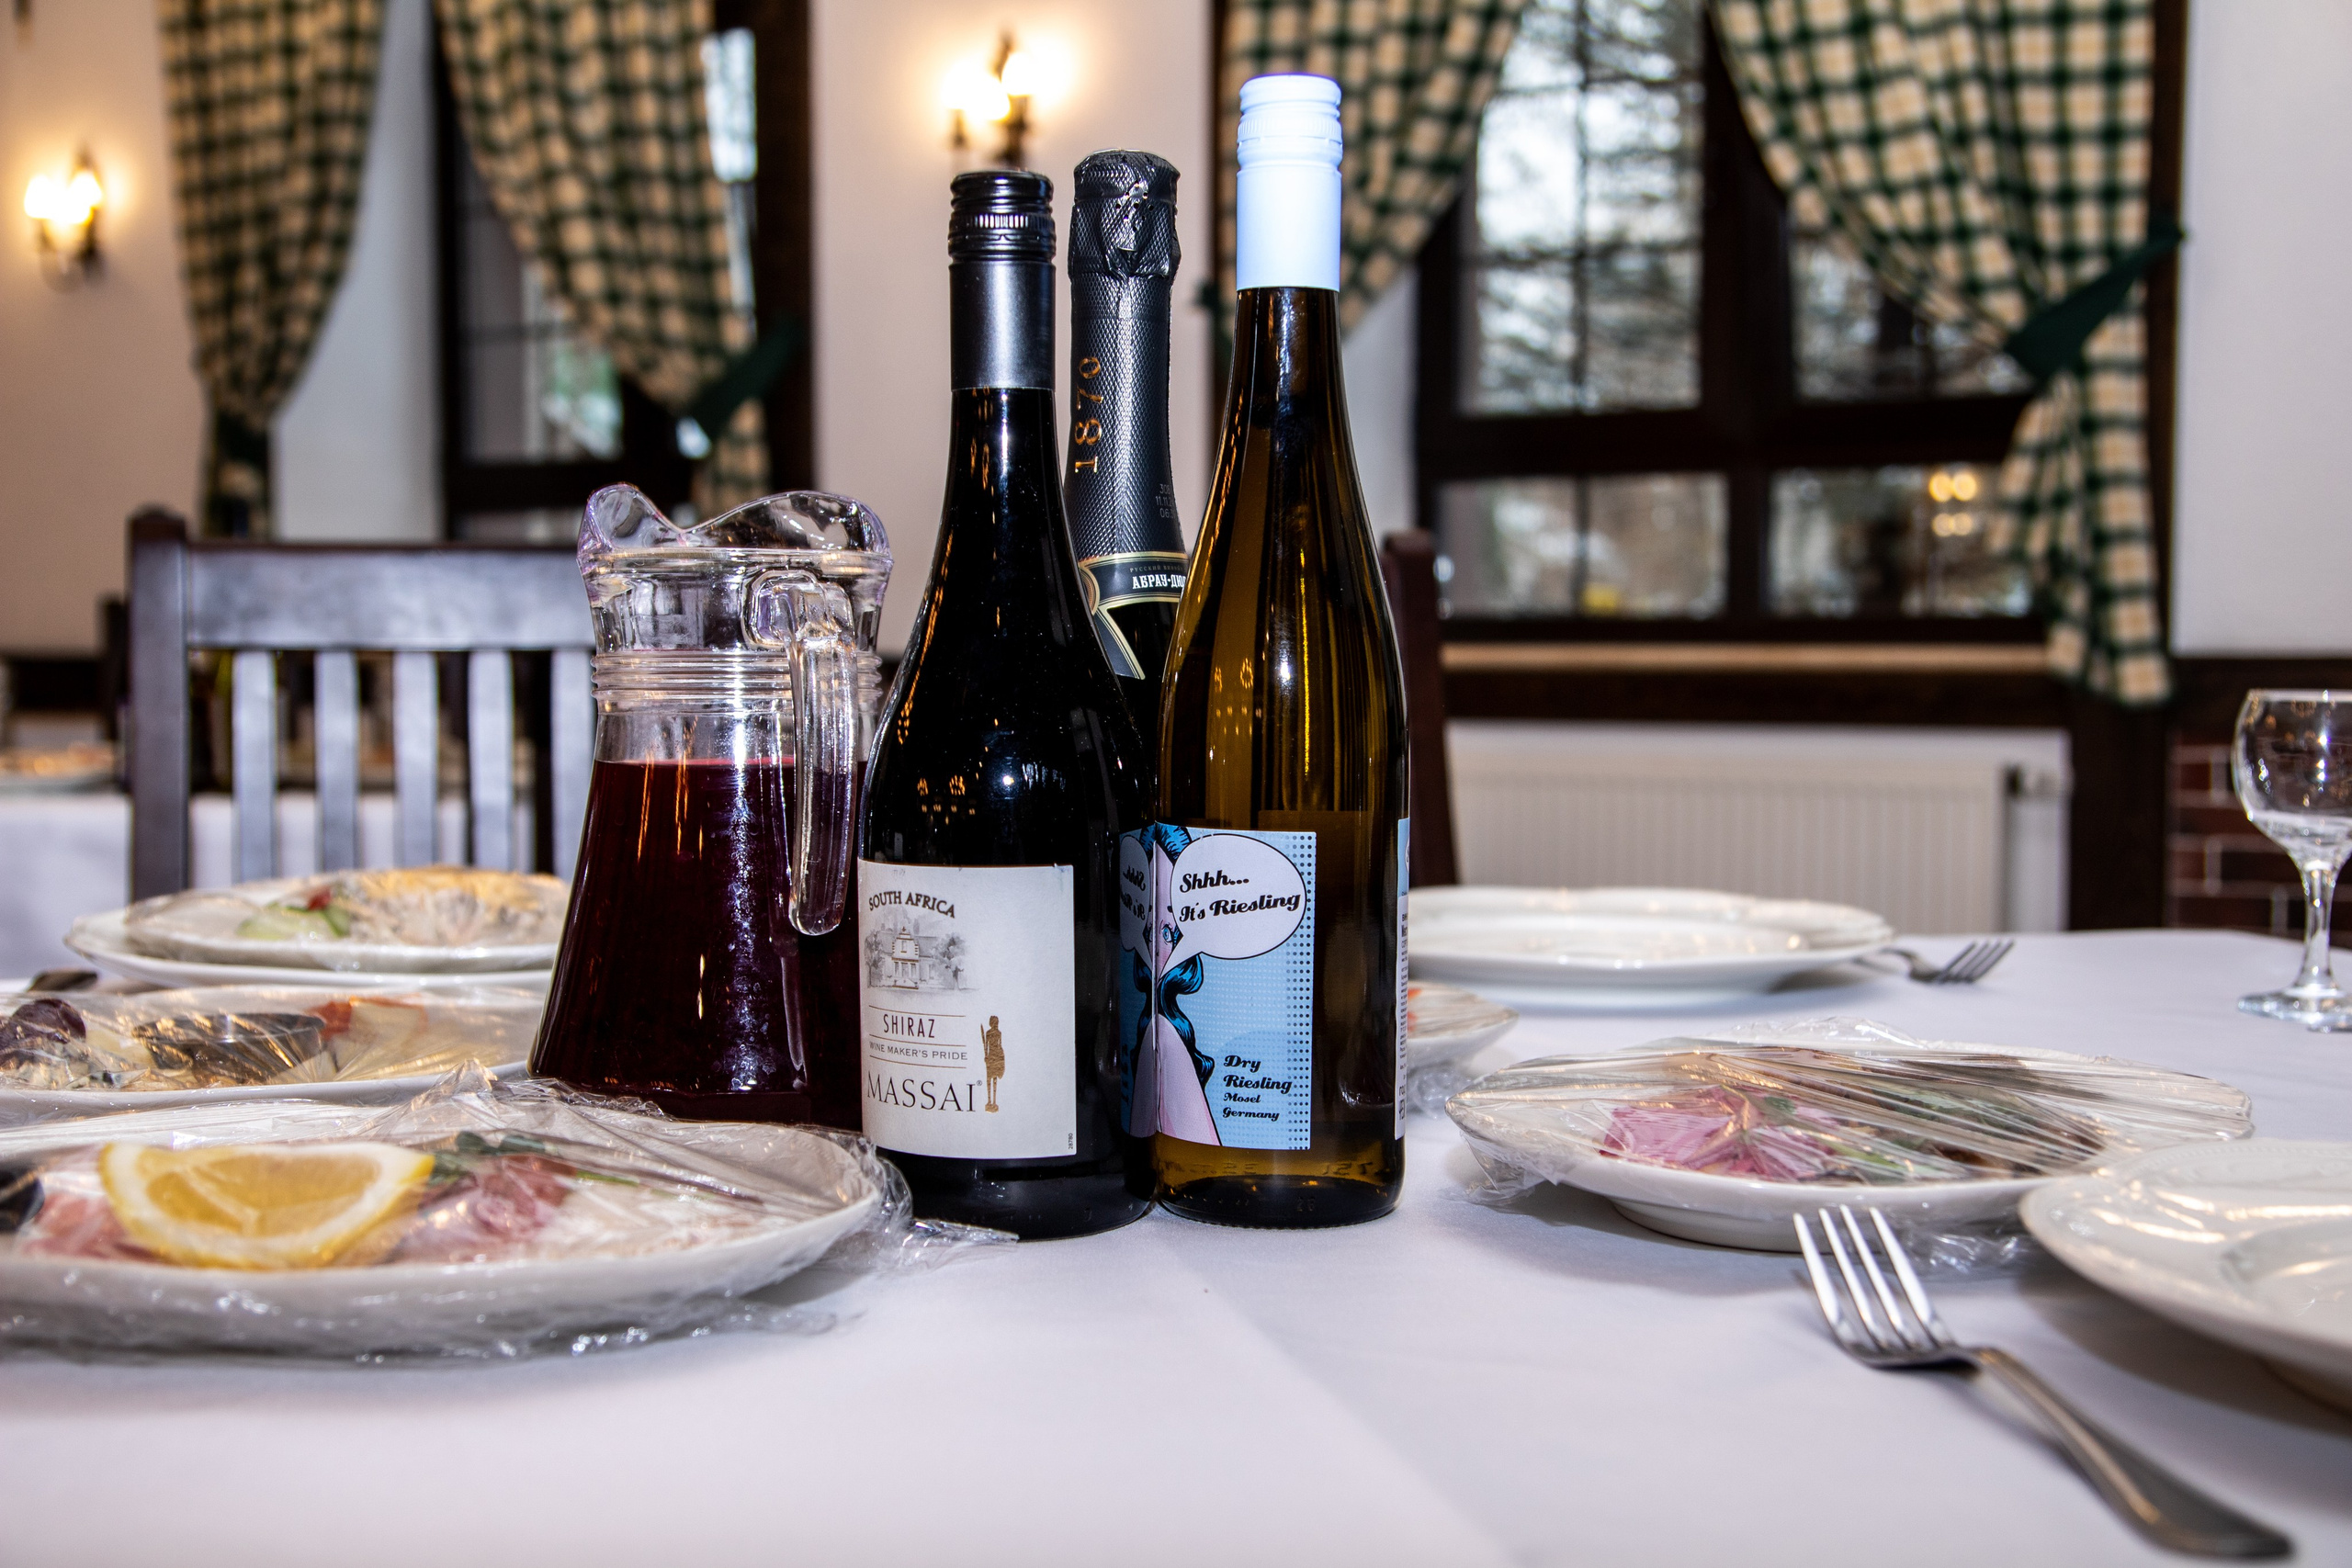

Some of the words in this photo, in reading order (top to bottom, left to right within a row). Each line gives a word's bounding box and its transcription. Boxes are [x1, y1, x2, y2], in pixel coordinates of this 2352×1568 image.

[1074, 355, 1104, 474] 1870
[1179, 869, 1250, 893] Shhh...
[868, 890, 902, 911] SOUTH
[905, 891, 956, 919] AFRICA
[1179, 902, 1206, 922] It's
[1209, 894, 1301, 917] Riesling
[883, 1013, 935, 1038] SHIRAZ
[869, 1041, 885, 1053] WINE
[887, 1045, 929, 1058] MAKER'S
[932, 1050, 968, 1061] PRIDE
[1223, 1055, 1261, 1073] Dry
[867, 1071, 977, 1112] MASSAI
[1223, 1074, 1293, 1095] Riesling
[1223, 1092, 1261, 1103] Mosel
[1222, 1106, 1280, 1122] Germany
